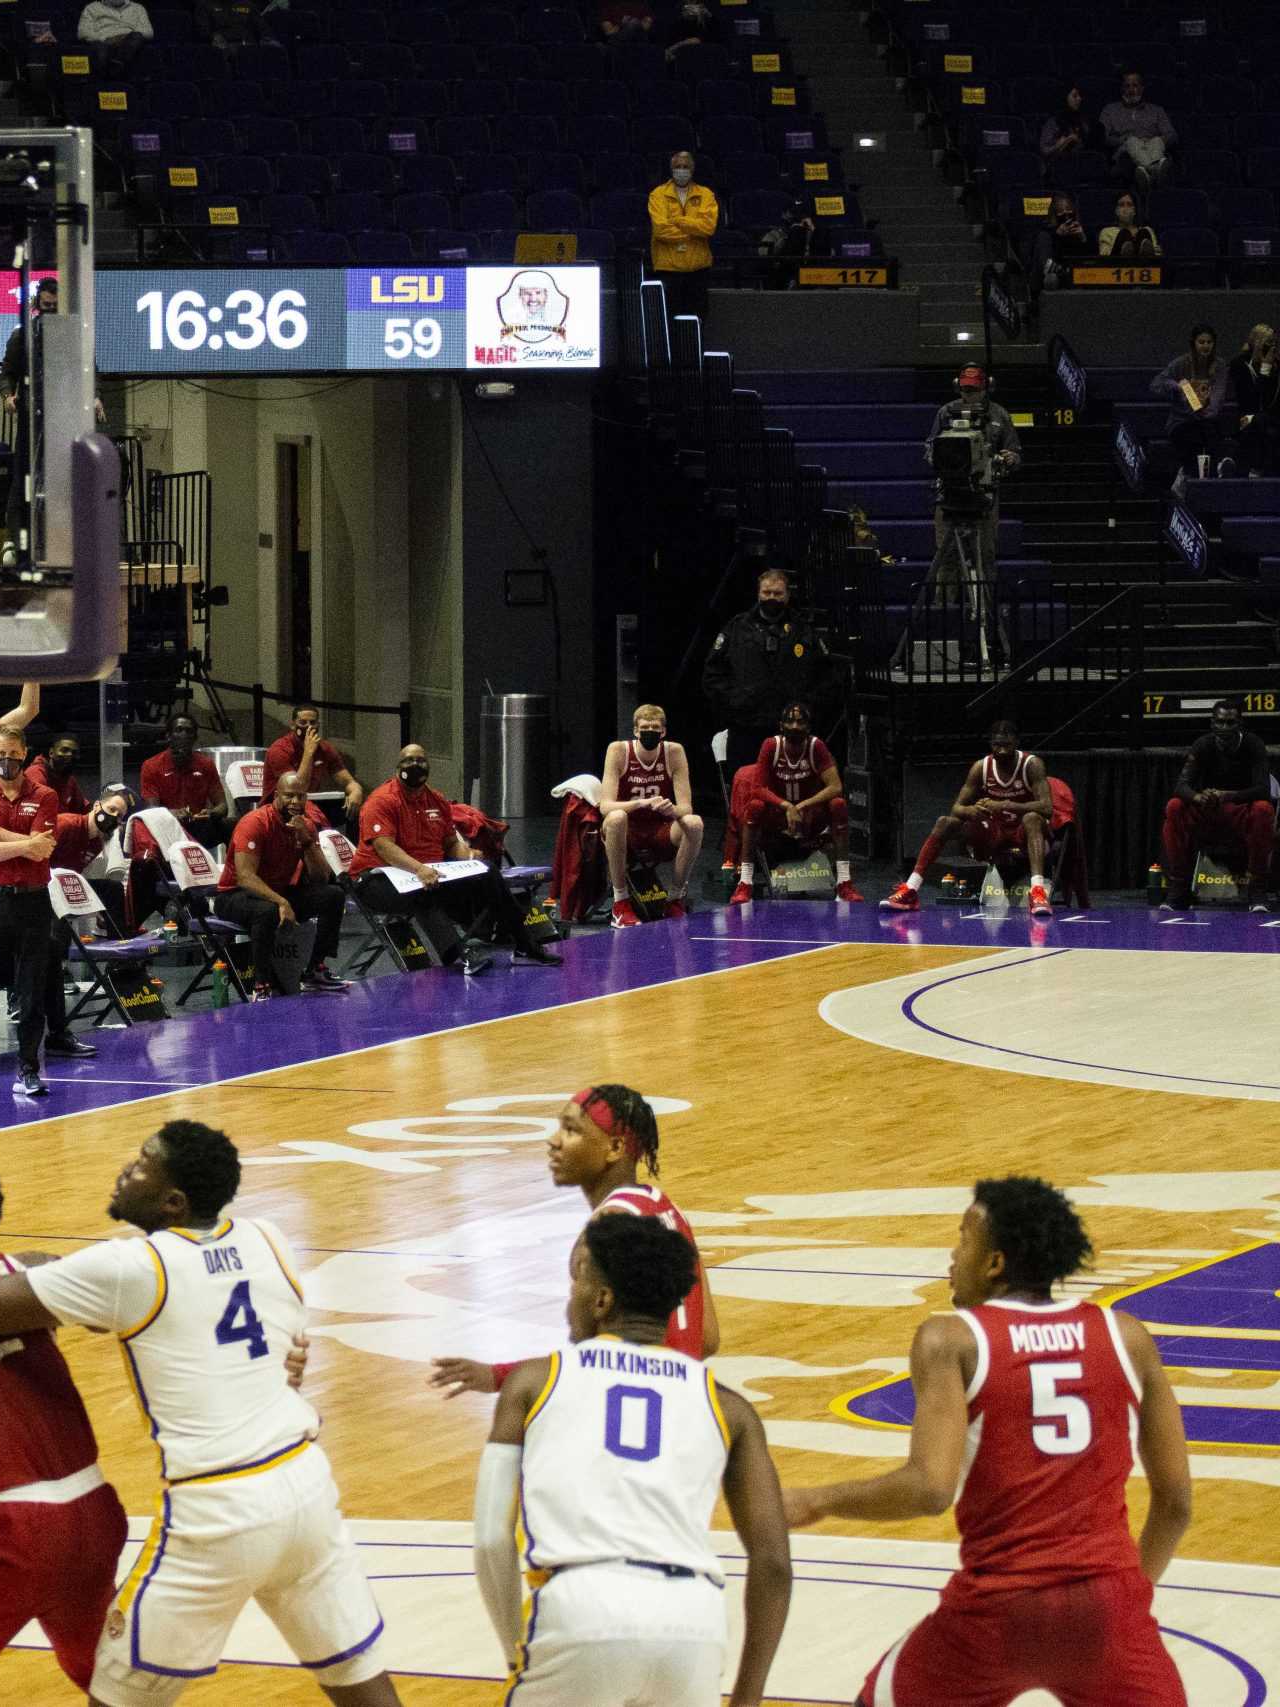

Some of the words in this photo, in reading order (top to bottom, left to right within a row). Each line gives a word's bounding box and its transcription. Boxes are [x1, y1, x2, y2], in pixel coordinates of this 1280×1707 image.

[371, 276, 444, 303] LSU
[837, 270, 878, 284] 117
[1111, 269, 1153, 284] 118
[136, 289, 308, 350] 16:36
[384, 318, 442, 359] 59
[474, 343, 518, 365] MAGIC
[1244, 694, 1275, 711] 118
[203, 1247, 243, 1274] DAYS
[215, 1279, 270, 1360] 4
[1008, 1322, 1086, 1354] MOODY
[579, 1349, 688, 1381] WILKINSON
[605, 1384, 663, 1462] 0
[1029, 1361, 1092, 1455] 5
